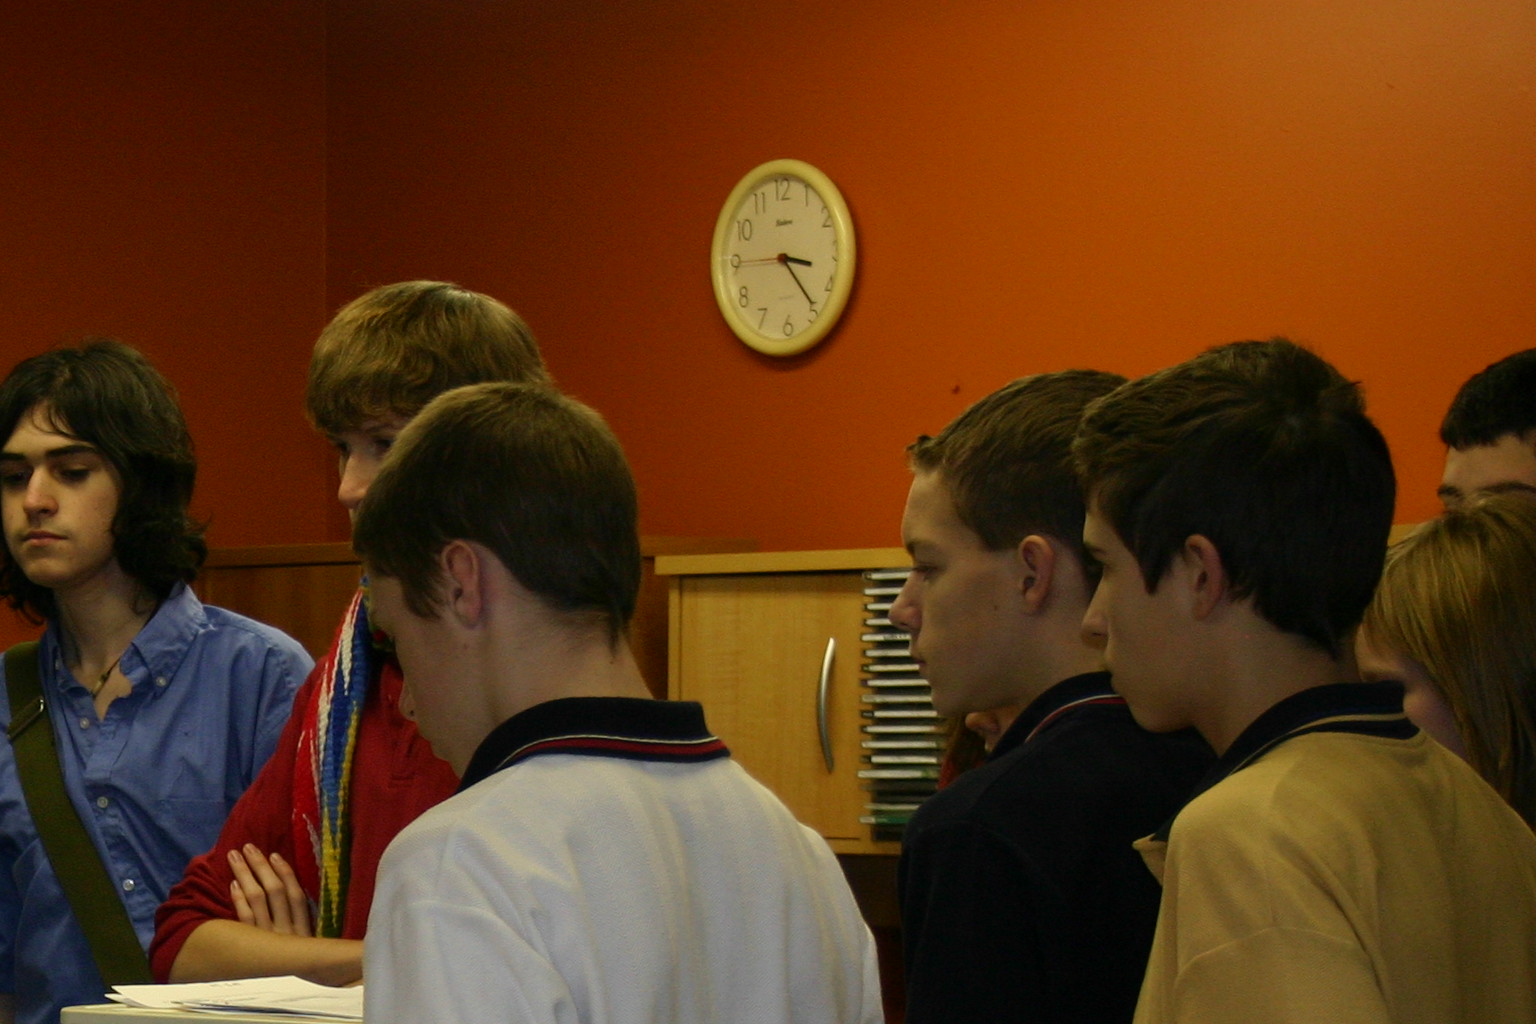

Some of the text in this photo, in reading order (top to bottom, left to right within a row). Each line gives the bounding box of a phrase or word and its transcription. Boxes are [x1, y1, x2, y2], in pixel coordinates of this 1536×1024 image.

[774, 178, 791, 201] 12
[804, 184, 809, 207] 1
[753, 192, 766, 214] 11
[820, 206, 832, 228] 2
[736, 219, 753, 241] 10
[730, 255, 740, 274] 9
[738, 286, 749, 308] 8
[757, 308, 768, 330] 7
[808, 301, 819, 324] 5
[782, 314, 794, 337] 6
